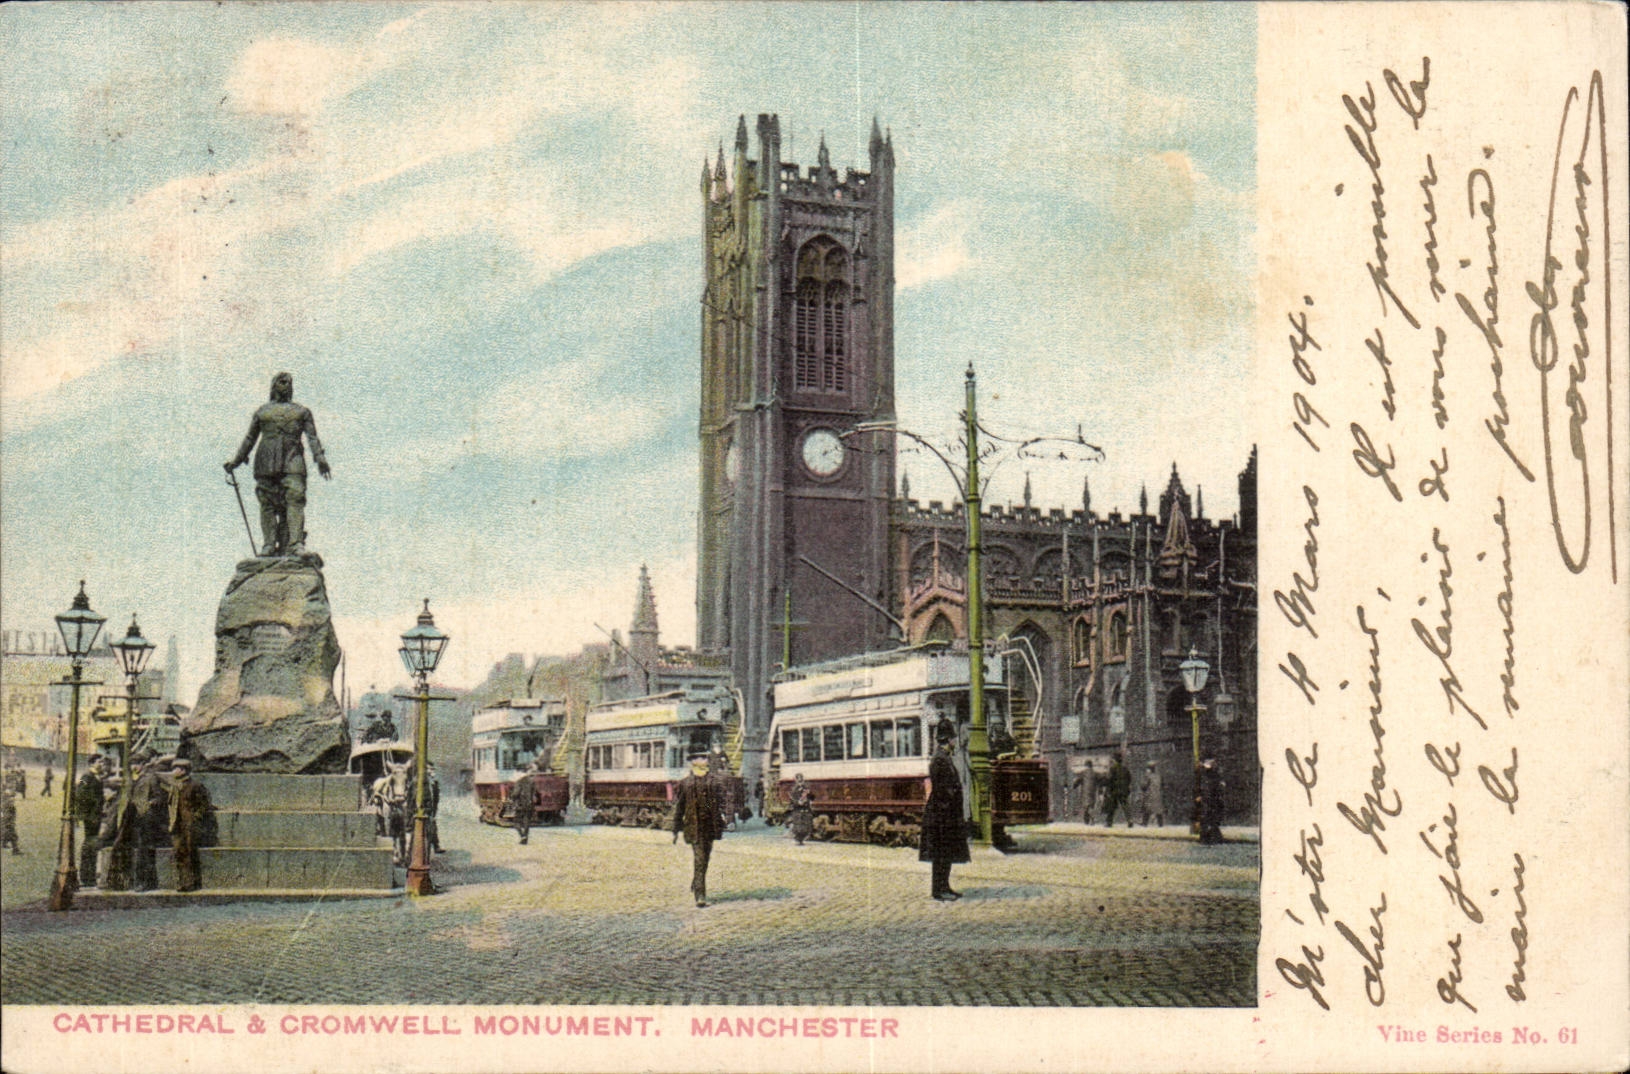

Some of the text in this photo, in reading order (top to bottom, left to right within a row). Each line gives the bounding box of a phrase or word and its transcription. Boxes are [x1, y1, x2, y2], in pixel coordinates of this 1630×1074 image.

[1384, 57, 1430, 130] la
[1336, 82, 1420, 329] possible
[1421, 155, 1445, 298] serrer
[1365, 329, 1395, 420] est
[1433, 328, 1448, 429] vous
[1351, 423, 1402, 501] Il
[1420, 449, 1448, 501] de
[1274, 486, 1319, 638] Mars
[1412, 528, 1487, 730] plaisir
[1478, 497, 1518, 713] semaine
[1011, 791, 1033, 801] 201
[1286, 743, 1317, 805] le
[1425, 744, 1460, 786] le
[1479, 748, 1518, 814] la
[1492, 854, 1527, 1001] main
[1437, 934, 1476, 1012] que
